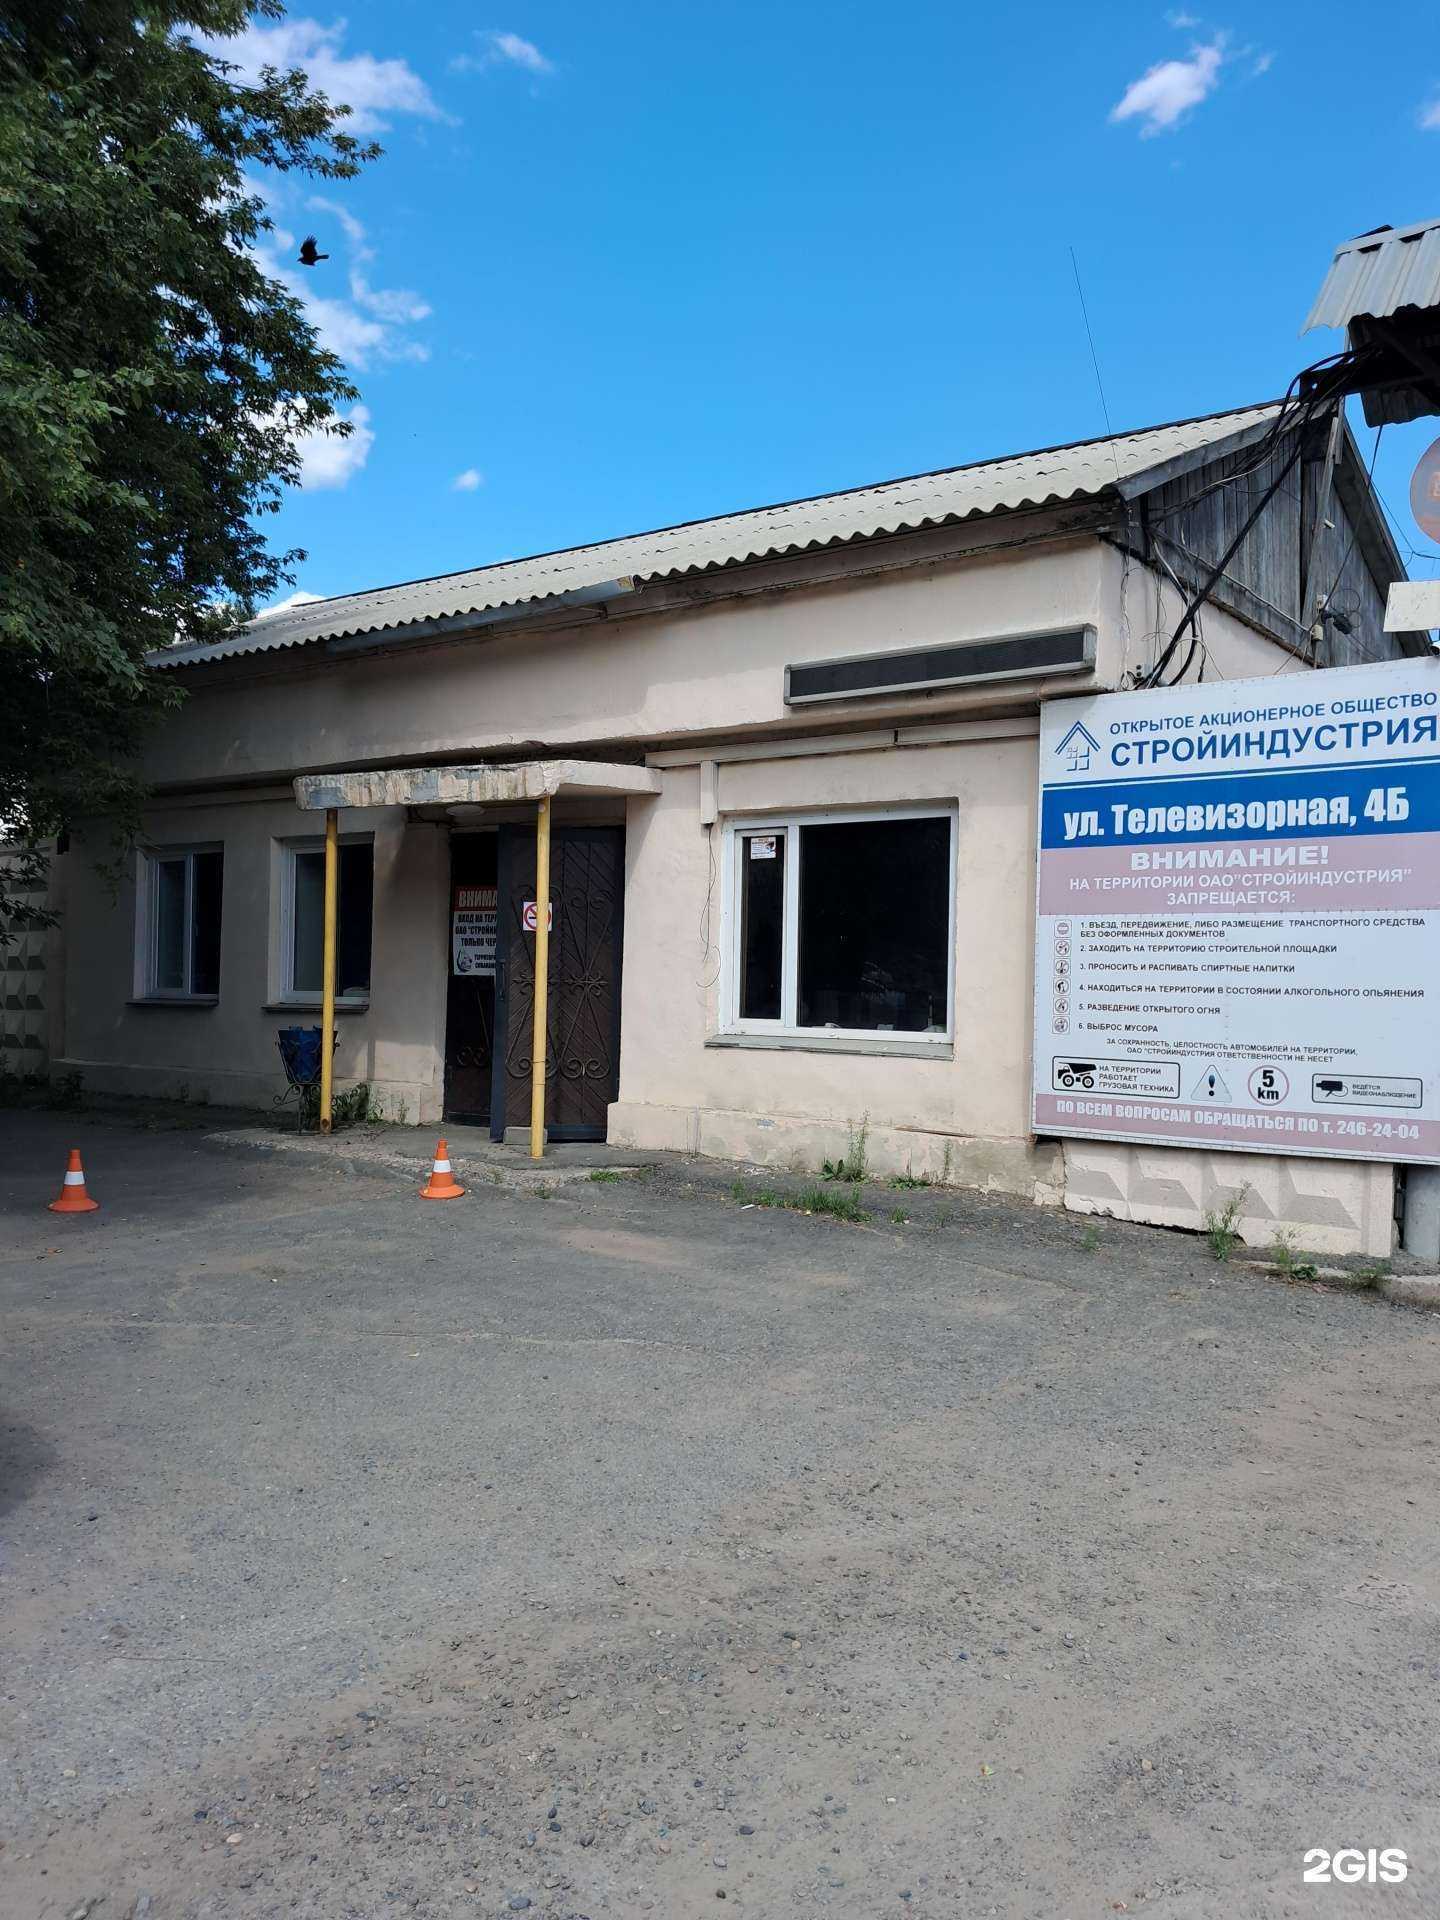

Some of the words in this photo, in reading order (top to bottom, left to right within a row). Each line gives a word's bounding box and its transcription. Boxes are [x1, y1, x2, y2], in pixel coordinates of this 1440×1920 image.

[1110, 716, 1194, 734] ОТКРЫТОЕ
[1200, 704, 1325, 727] АКЦИОНЕРНОЕ
[1331, 692, 1437, 714] ОБЩЕСТВО
[1111, 715, 1437, 766] СТРОЙИНДУСТРИЯ
[1063, 811, 1104, 841] ул.
[1111, 796, 1357, 835] Телевизорная,
[1364, 786, 1411, 822] 4Б
[1131, 846, 1329, 870] ВНИМАНИЕ!
[1069, 878, 1090, 890] НА
[1094, 875, 1194, 890] ТЕРРИТОРИИ
[459, 890, 497, 907] ВНИМА
[1167, 891, 1296, 906] ЗАПРЕЩАЕТСЯ:
[1121, 921, 1192, 930] ПЕРЕДВИЖЕНИЕ,
[1194, 920, 1219, 928] ЛИБО
[1221, 920, 1284, 928] РАЗМЕЩЕНИЕ
[1289, 919, 1370, 927] ТРАНСПОРТНОГО
[1372, 918, 1426, 927] СРЕДСТВА
[1098, 930, 1164, 938] ОФОРМЛЕННЫХ
[1166, 930, 1226, 939] ДОКУМЕНТОВ
[1088, 945, 1132, 953] ЗАХОДИТЬ
[1208, 944, 1281, 952] СТРОИТЕЛЬНОЙ
[1283, 945, 1337, 953] ПЛОЩАДКИ
[1088, 963, 1138, 971] ПРОНОСИТЬ
[1148, 964, 1199, 972] РАСПИВАТЬ
[1201, 964, 1251, 972] СПИРТНЫЕ
[1252, 965, 1295, 973] НАПИТКИ
[1087, 984, 1142, 992] НАХОДИТЬСЯ
[1144, 985, 1157, 993] НА
[1159, 985, 1215, 994] ТЕРРИТОРИИ
[1226, 987, 1281, 995] СОСТОЯНИИ
[1284, 988, 1360, 997] АЛКОГОЛЬНОГО
[1362, 989, 1425, 998] ОПЬЯНЕНИЯ
[1087, 1003, 1140, 1013] РАЗВЕДЕНИЕ
[1142, 1005, 1195, 1014] ОТКРЫТОГО
[1196, 1006, 1221, 1015] ОГНЯ
[1087, 1023, 1122, 1031] ВЫБРОС
[1124, 1024, 1159, 1033] МУСОРА
[1173, 1041, 1228, 1050] ЦЕЛОСТНОСТЬ
[1230, 1043, 1288, 1052] АВТОМОБИЛЕЙ
[1303, 1046, 1358, 1056] ТЕРРИТОРИИ,
[1216, 1051, 1293, 1061] ОТВЕТСТВЕННОСТИ
[1307, 1055, 1333, 1063] НЕСЕТ
[1111, 1066, 1162, 1075] ТЕРРИТОРИИ
[1099, 1073, 1138, 1082] РАБОТАЕТ
[1262, 1069, 1275, 1088] 5
[1098, 1082, 1138, 1090] ГРУЗОВАЯ
[1139, 1084, 1175, 1093] ТЕХНИКА
[1257, 1087, 1280, 1100] km
[1056, 1100, 1074, 1114] ПО
[1076, 1102, 1112, 1117] ВСЕМ
[1115, 1104, 1191, 1123] ВОПРОСАМ
[1194, 1109, 1295, 1131] ОБРАЩАТЬСЯ
[1297, 1117, 1319, 1133] ПО
[1336, 1121, 1419, 1139] 246-24-04
